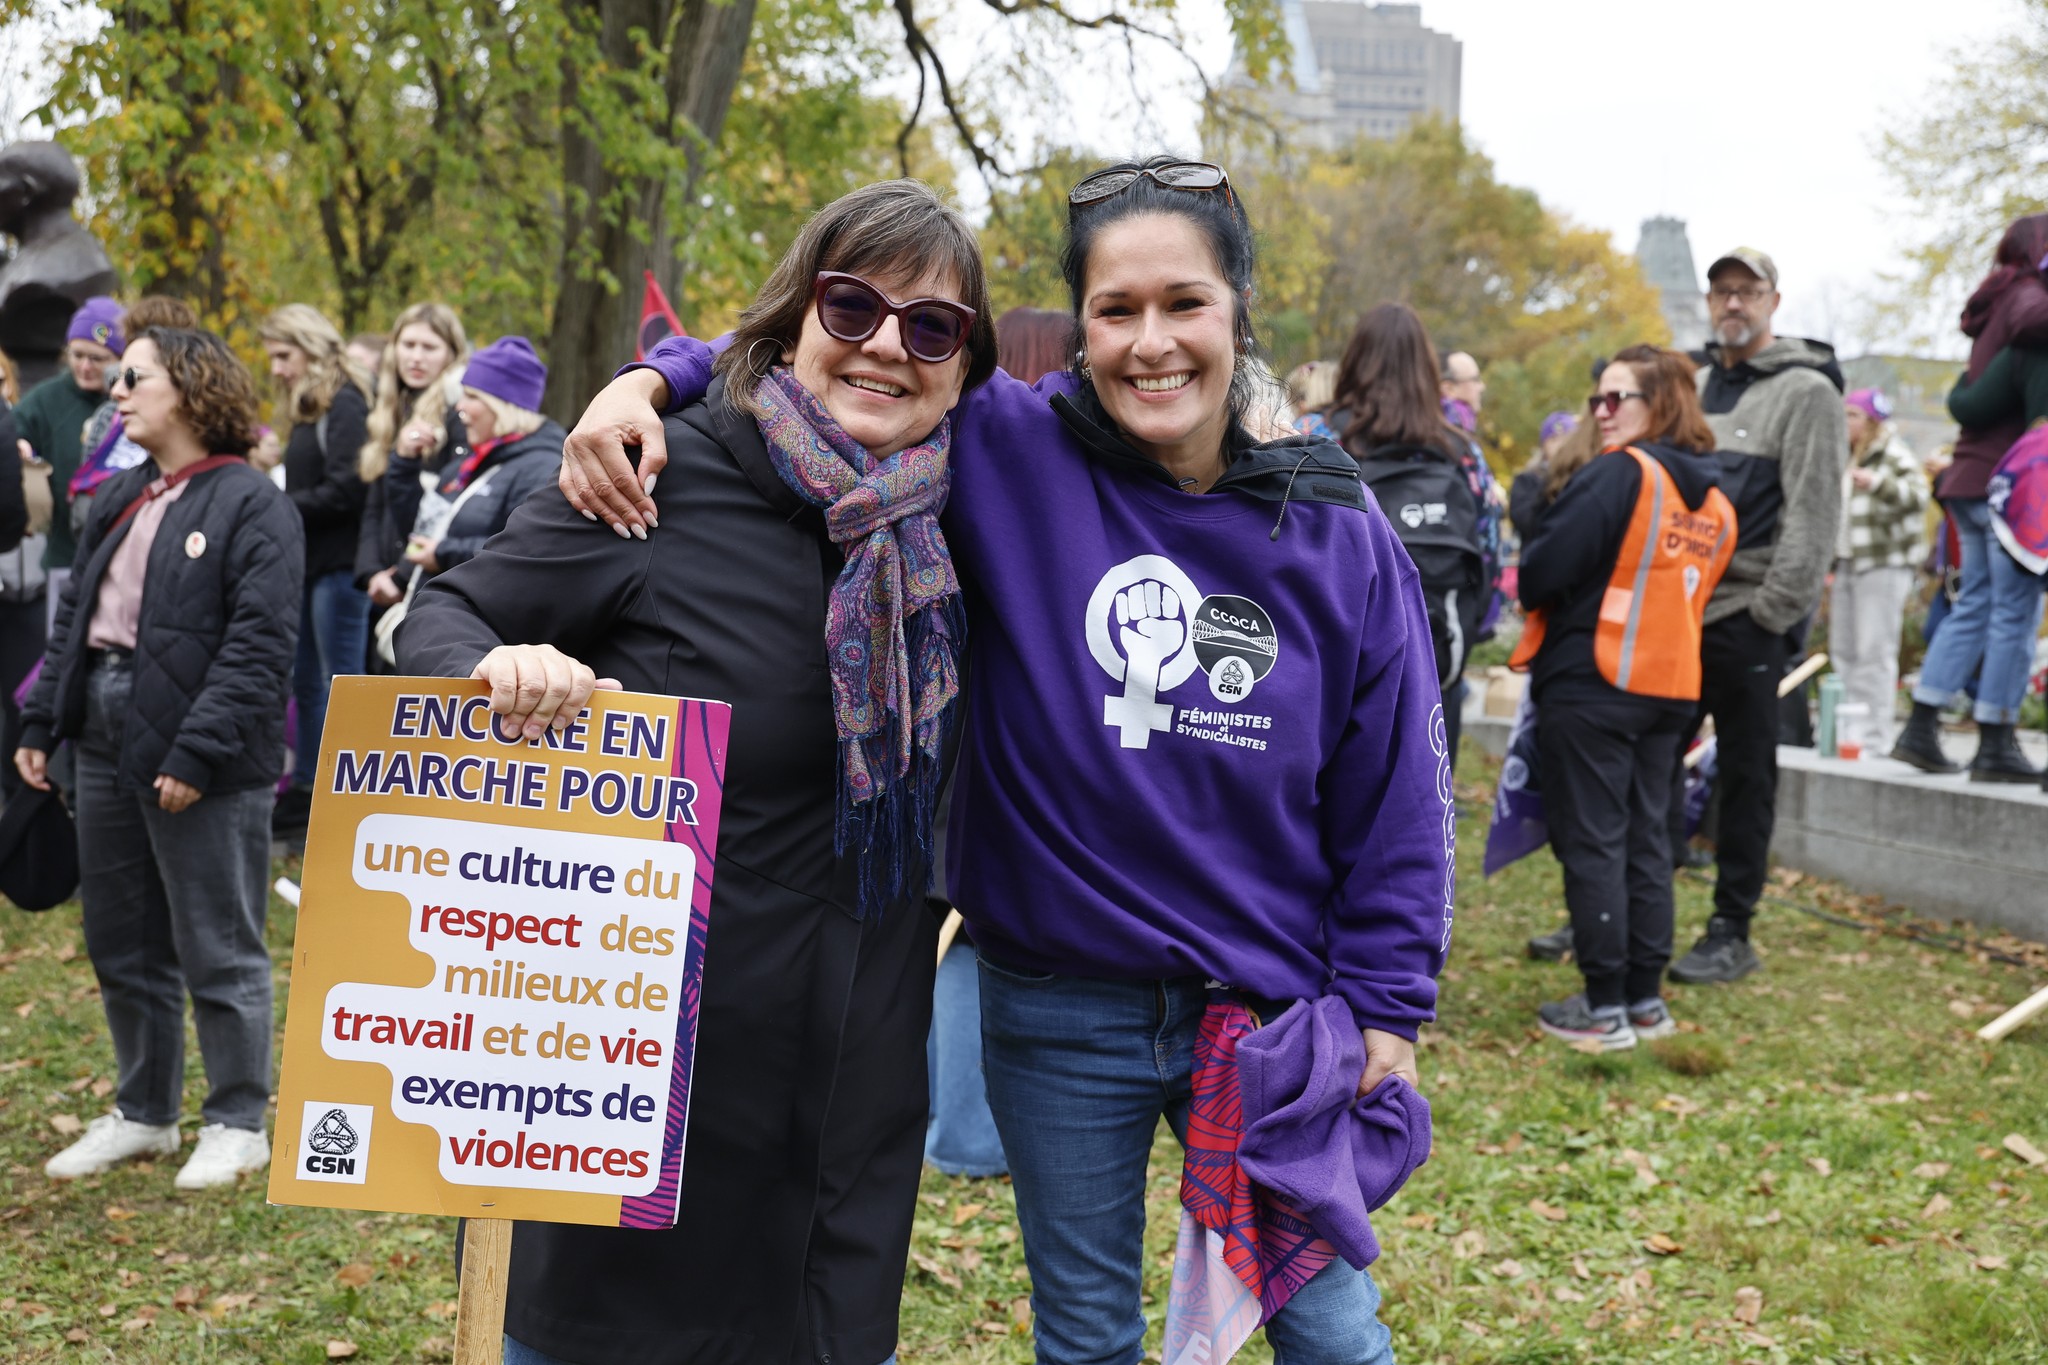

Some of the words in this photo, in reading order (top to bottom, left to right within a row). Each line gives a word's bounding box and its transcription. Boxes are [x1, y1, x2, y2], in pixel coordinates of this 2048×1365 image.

[1210, 608, 1260, 632] CCQCA
[1218, 684, 1242, 695] CSN
[600, 709, 669, 761] EN
[1176, 724, 1267, 751] SYNDICALISTES
[1179, 707, 1272, 729] FÉMINISTES
[1219, 725, 1229, 733] et
[332, 750, 549, 809] MARCHE
[558, 766, 699, 825] POUR
[365, 843, 449, 876] une
[459, 847, 615, 893] culture
[625, 860, 680, 900] du
[421, 905, 582, 951] respect
[600, 914, 675, 955] des
[445, 960, 607, 1006] milieux
[615, 972, 668, 1011] de
[332, 1007, 474, 1051] travail
[483, 1023, 528, 1056] et
[537, 1022, 590, 1061] de
[600, 1028, 662, 1067] vie
[402, 1076, 593, 1123] exempts
[602, 1083, 655, 1122] de
[306, 1154, 355, 1175] CSN
[449, 1129, 649, 1178] violences
